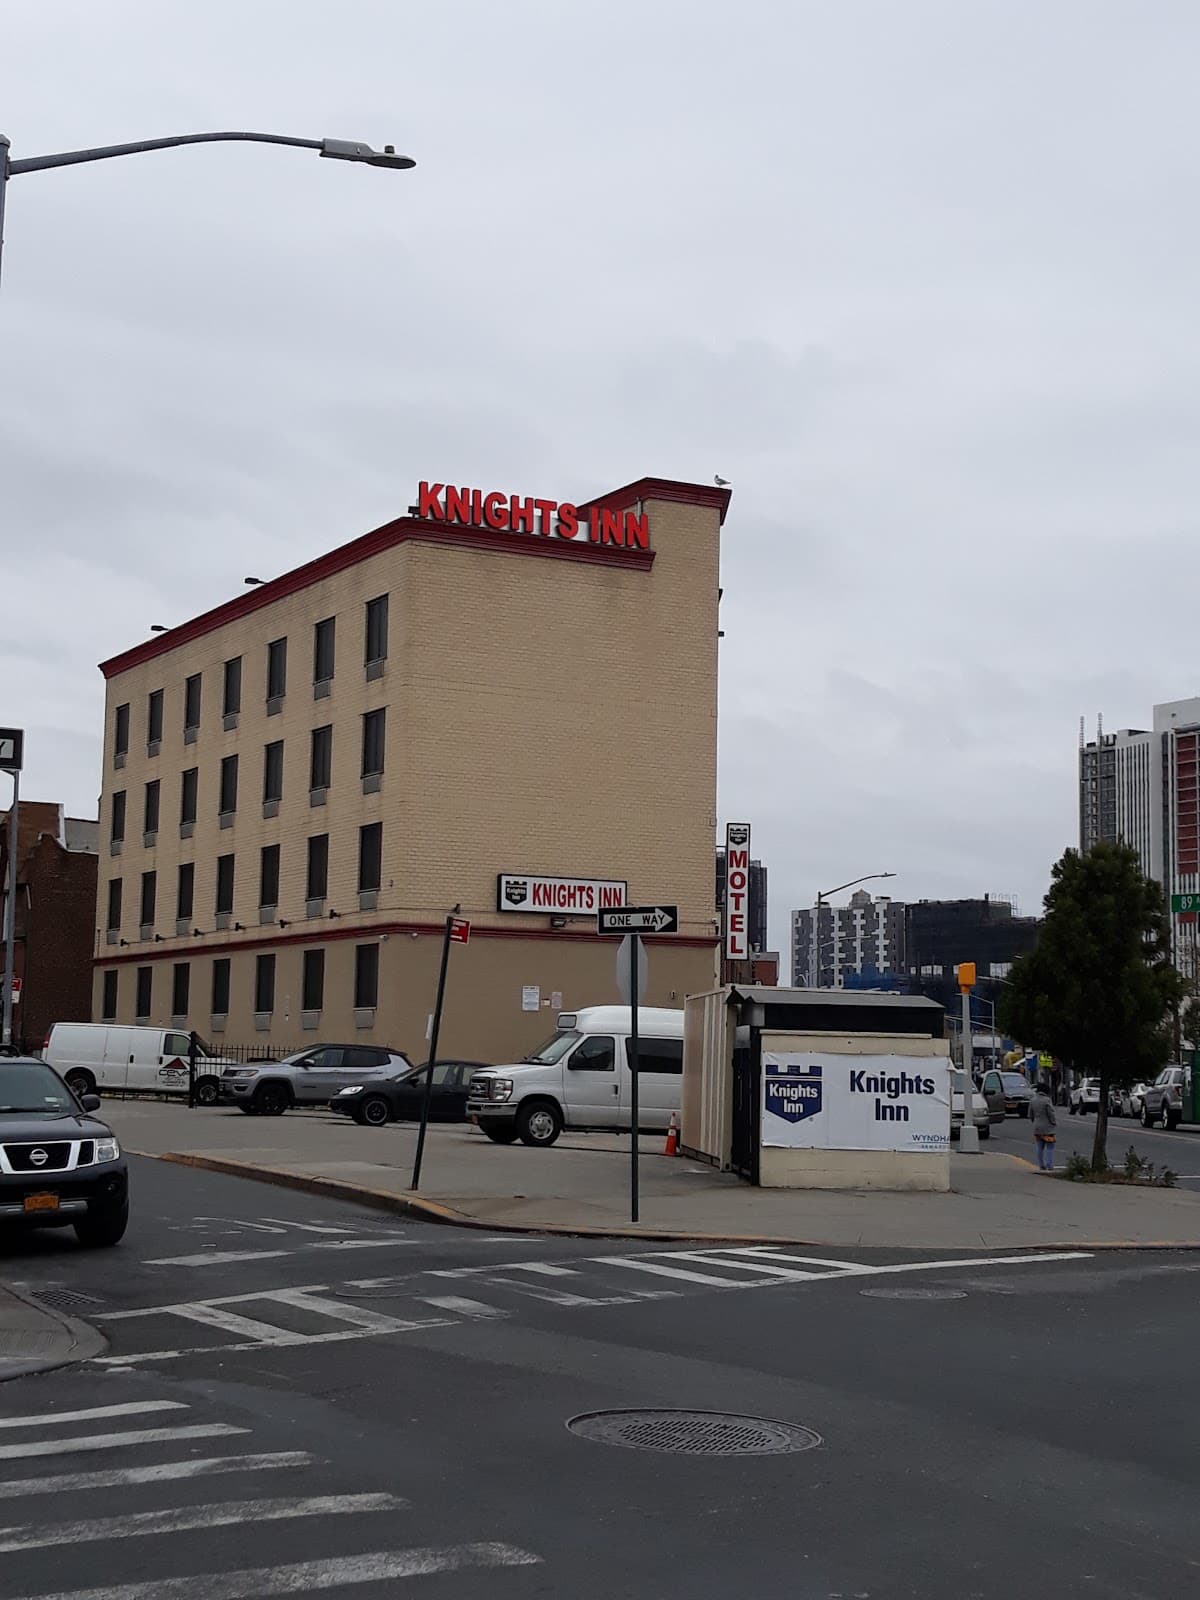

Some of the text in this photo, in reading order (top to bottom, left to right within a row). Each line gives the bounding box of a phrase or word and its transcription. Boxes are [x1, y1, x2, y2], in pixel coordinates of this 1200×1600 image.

[418, 480, 649, 549] KNIGHTS INN
[532, 883, 622, 909] KNIGHTS INN
[729, 850, 747, 954] MOTEL
[1181, 896, 1193, 910] 89
[609, 914, 665, 926] ONE WAY
[769, 1083, 818, 1100] Knights
[850, 1070, 935, 1099] Knights
[783, 1099, 804, 1113] Inn
[875, 1098, 909, 1121] Inn
